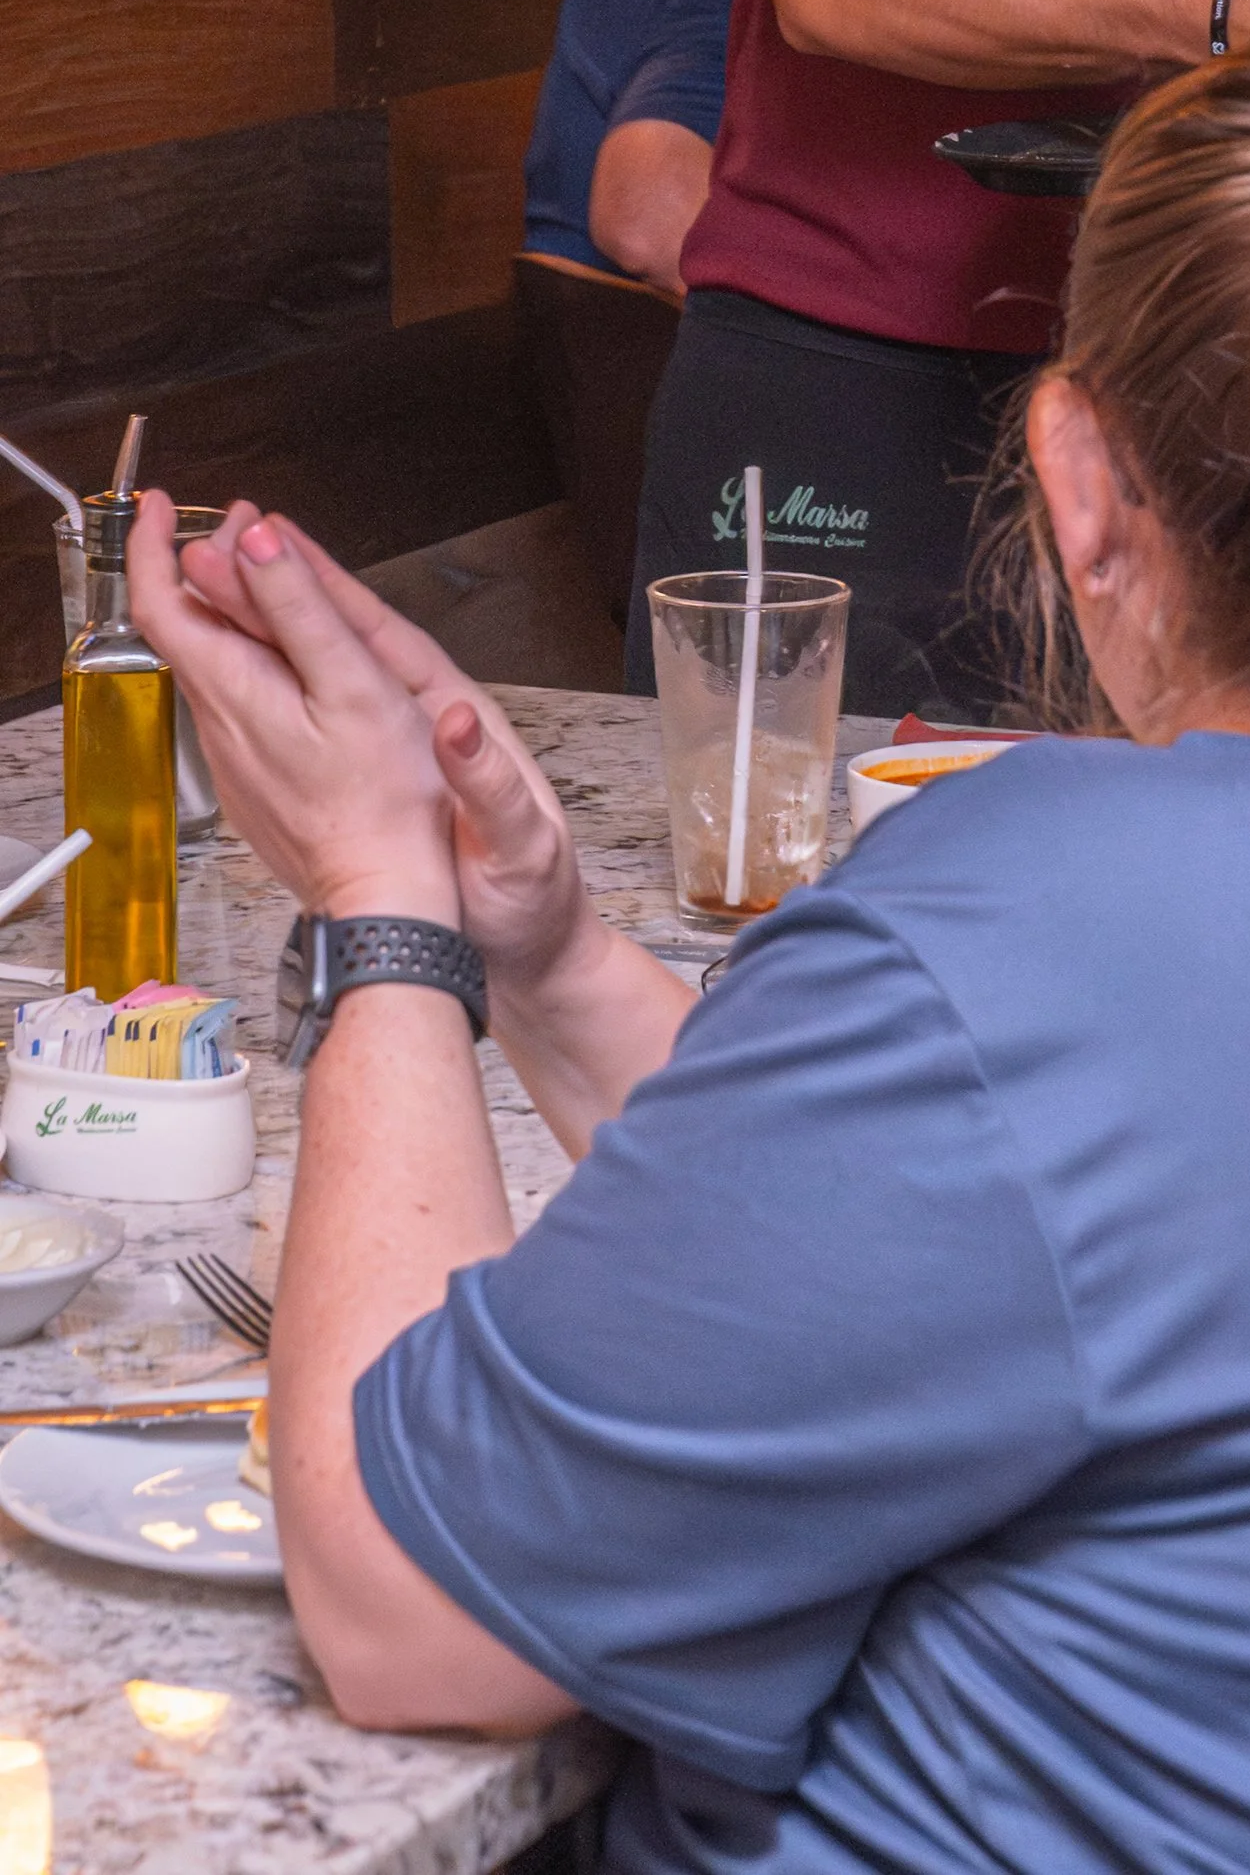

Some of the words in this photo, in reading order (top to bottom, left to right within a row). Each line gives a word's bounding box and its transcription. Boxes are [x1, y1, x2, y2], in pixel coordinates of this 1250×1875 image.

[712, 477, 750, 542] L
[767, 485, 870, 532] Marsa
[36, 1096, 67, 1137] La
[73, 1103, 137, 1125] Marsa
